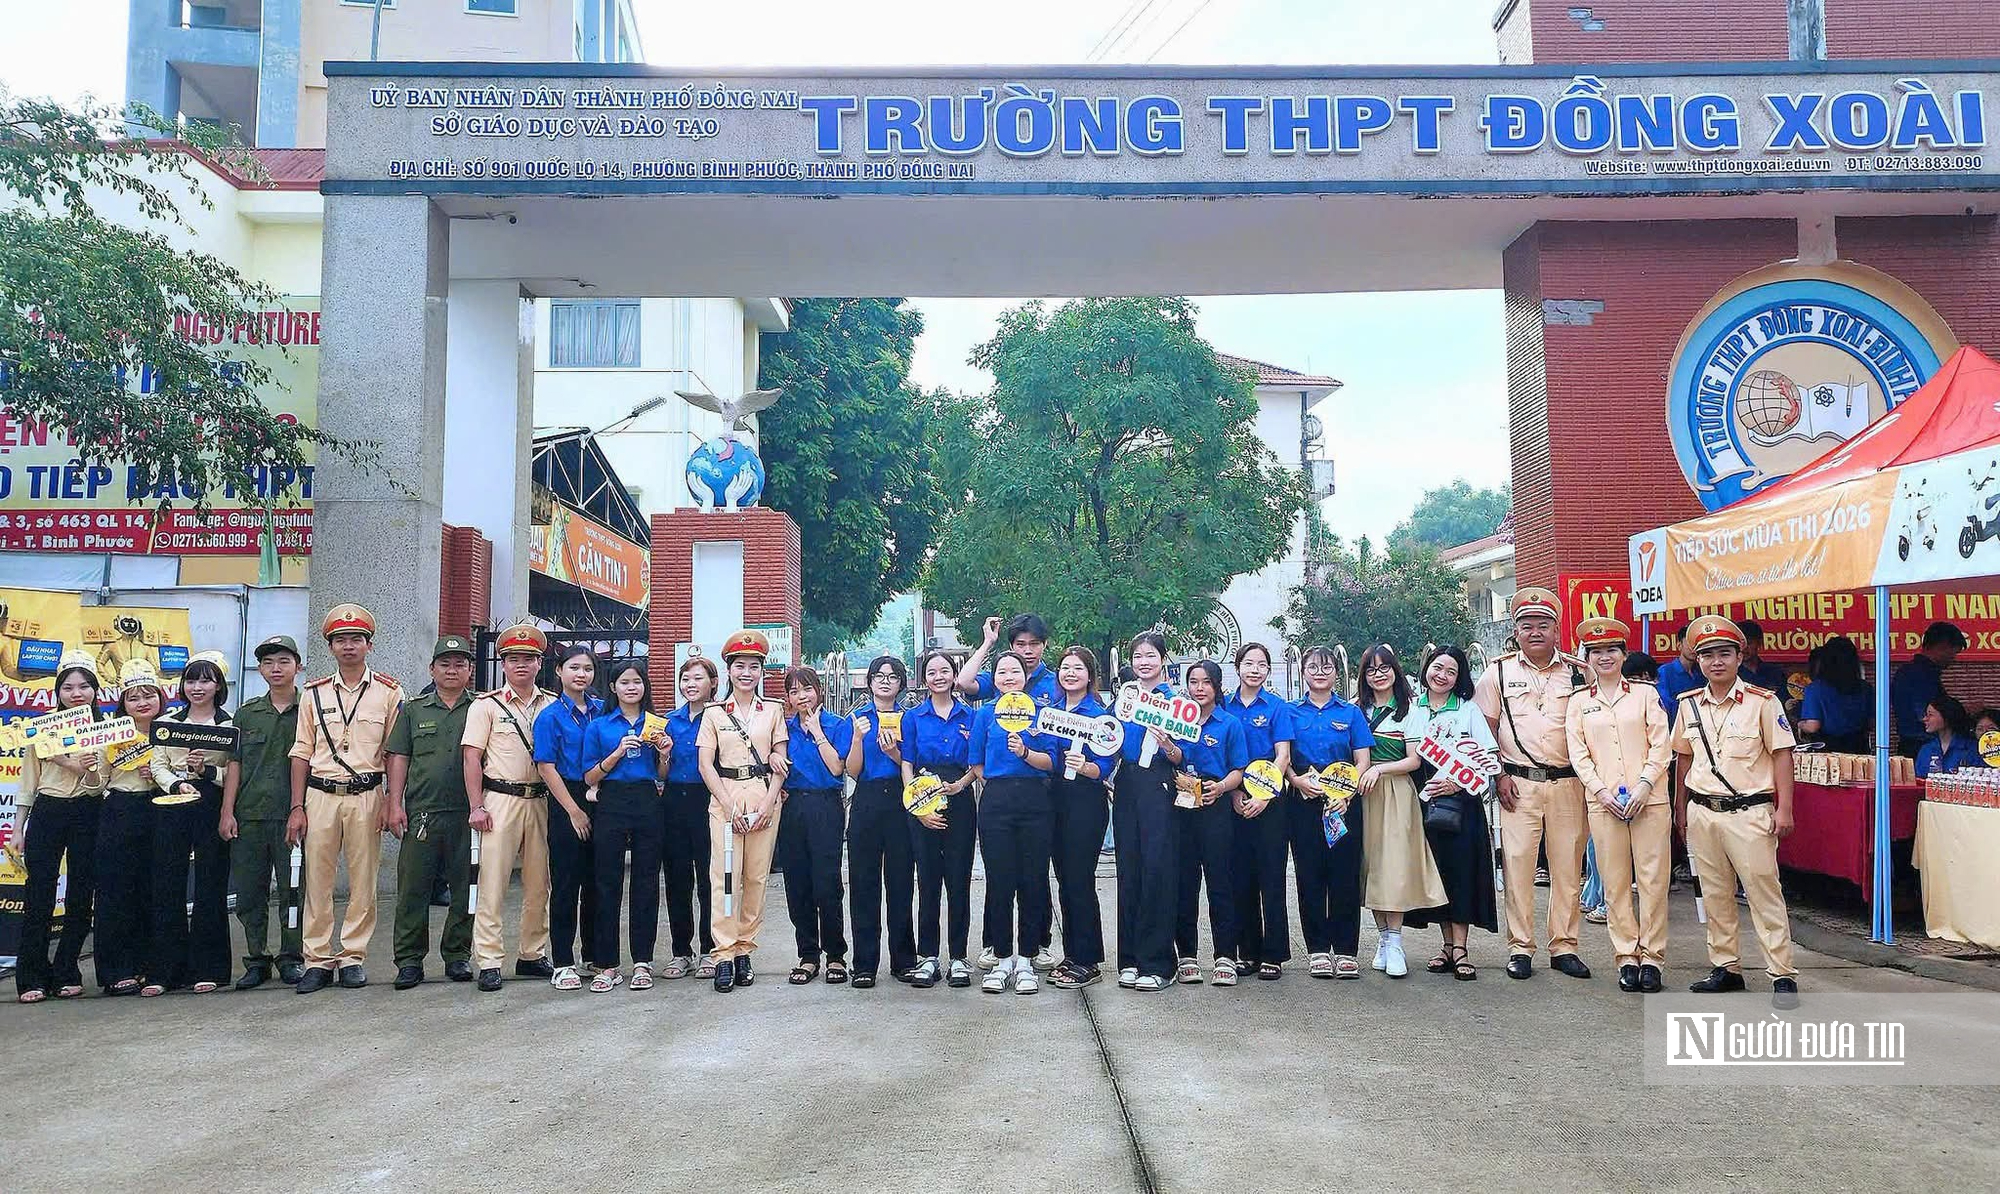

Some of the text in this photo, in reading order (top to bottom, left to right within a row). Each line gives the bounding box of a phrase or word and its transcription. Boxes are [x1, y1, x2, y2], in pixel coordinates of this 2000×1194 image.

[371, 82, 799, 110] UỶ BAN NHÂN DÂN THÀNH PHỐ ĐỒNG NAI
[431, 110, 720, 140] SỞ GIÁO DỤC VÀ ĐÀO TẠO
[799, 74, 1987, 158] TRƯỜNG THPT ĐỒNG XOÀI
[390, 156, 975, 180] ĐỊA CHỈ: SỐ 901 QUỐC LỘ 14, PHƯỜNG BÌNH PHƯỚC, THÀNH PHỐ ĐỒNG NAI
[1583, 155, 1983, 175] Website: www.thptdongxoai.edu.vn ĐT: 02713.883.090
[1710, 324, 1759, 377] THPT
[15, 514, 31, 531] 3,
[36, 513, 54, 528] số
[59, 514, 91, 528] 463
[96, 514, 118, 528] QL
[125, 514, 149, 530] 14,
[1743, 519, 1783, 552] MÙA
[1787, 513, 1818, 542] THI
[1820, 502, 1871, 536] 2026
[24, 535, 37, 548] T.
[84, 534, 134, 548] Phước
[578, 538, 602, 579] CĂN
[604, 554, 622, 588] TIN
[1581, 586, 1619, 622] KỲ
[1172, 698, 1199, 723] 10
[118, 728, 135, 740] 10
[1056, 724, 1077, 737] CHO
[1164, 717, 1199, 740] BẠN!
[1420, 736, 1486, 793] THI TỐT
[1455, 740, 1499, 773] Chúc
